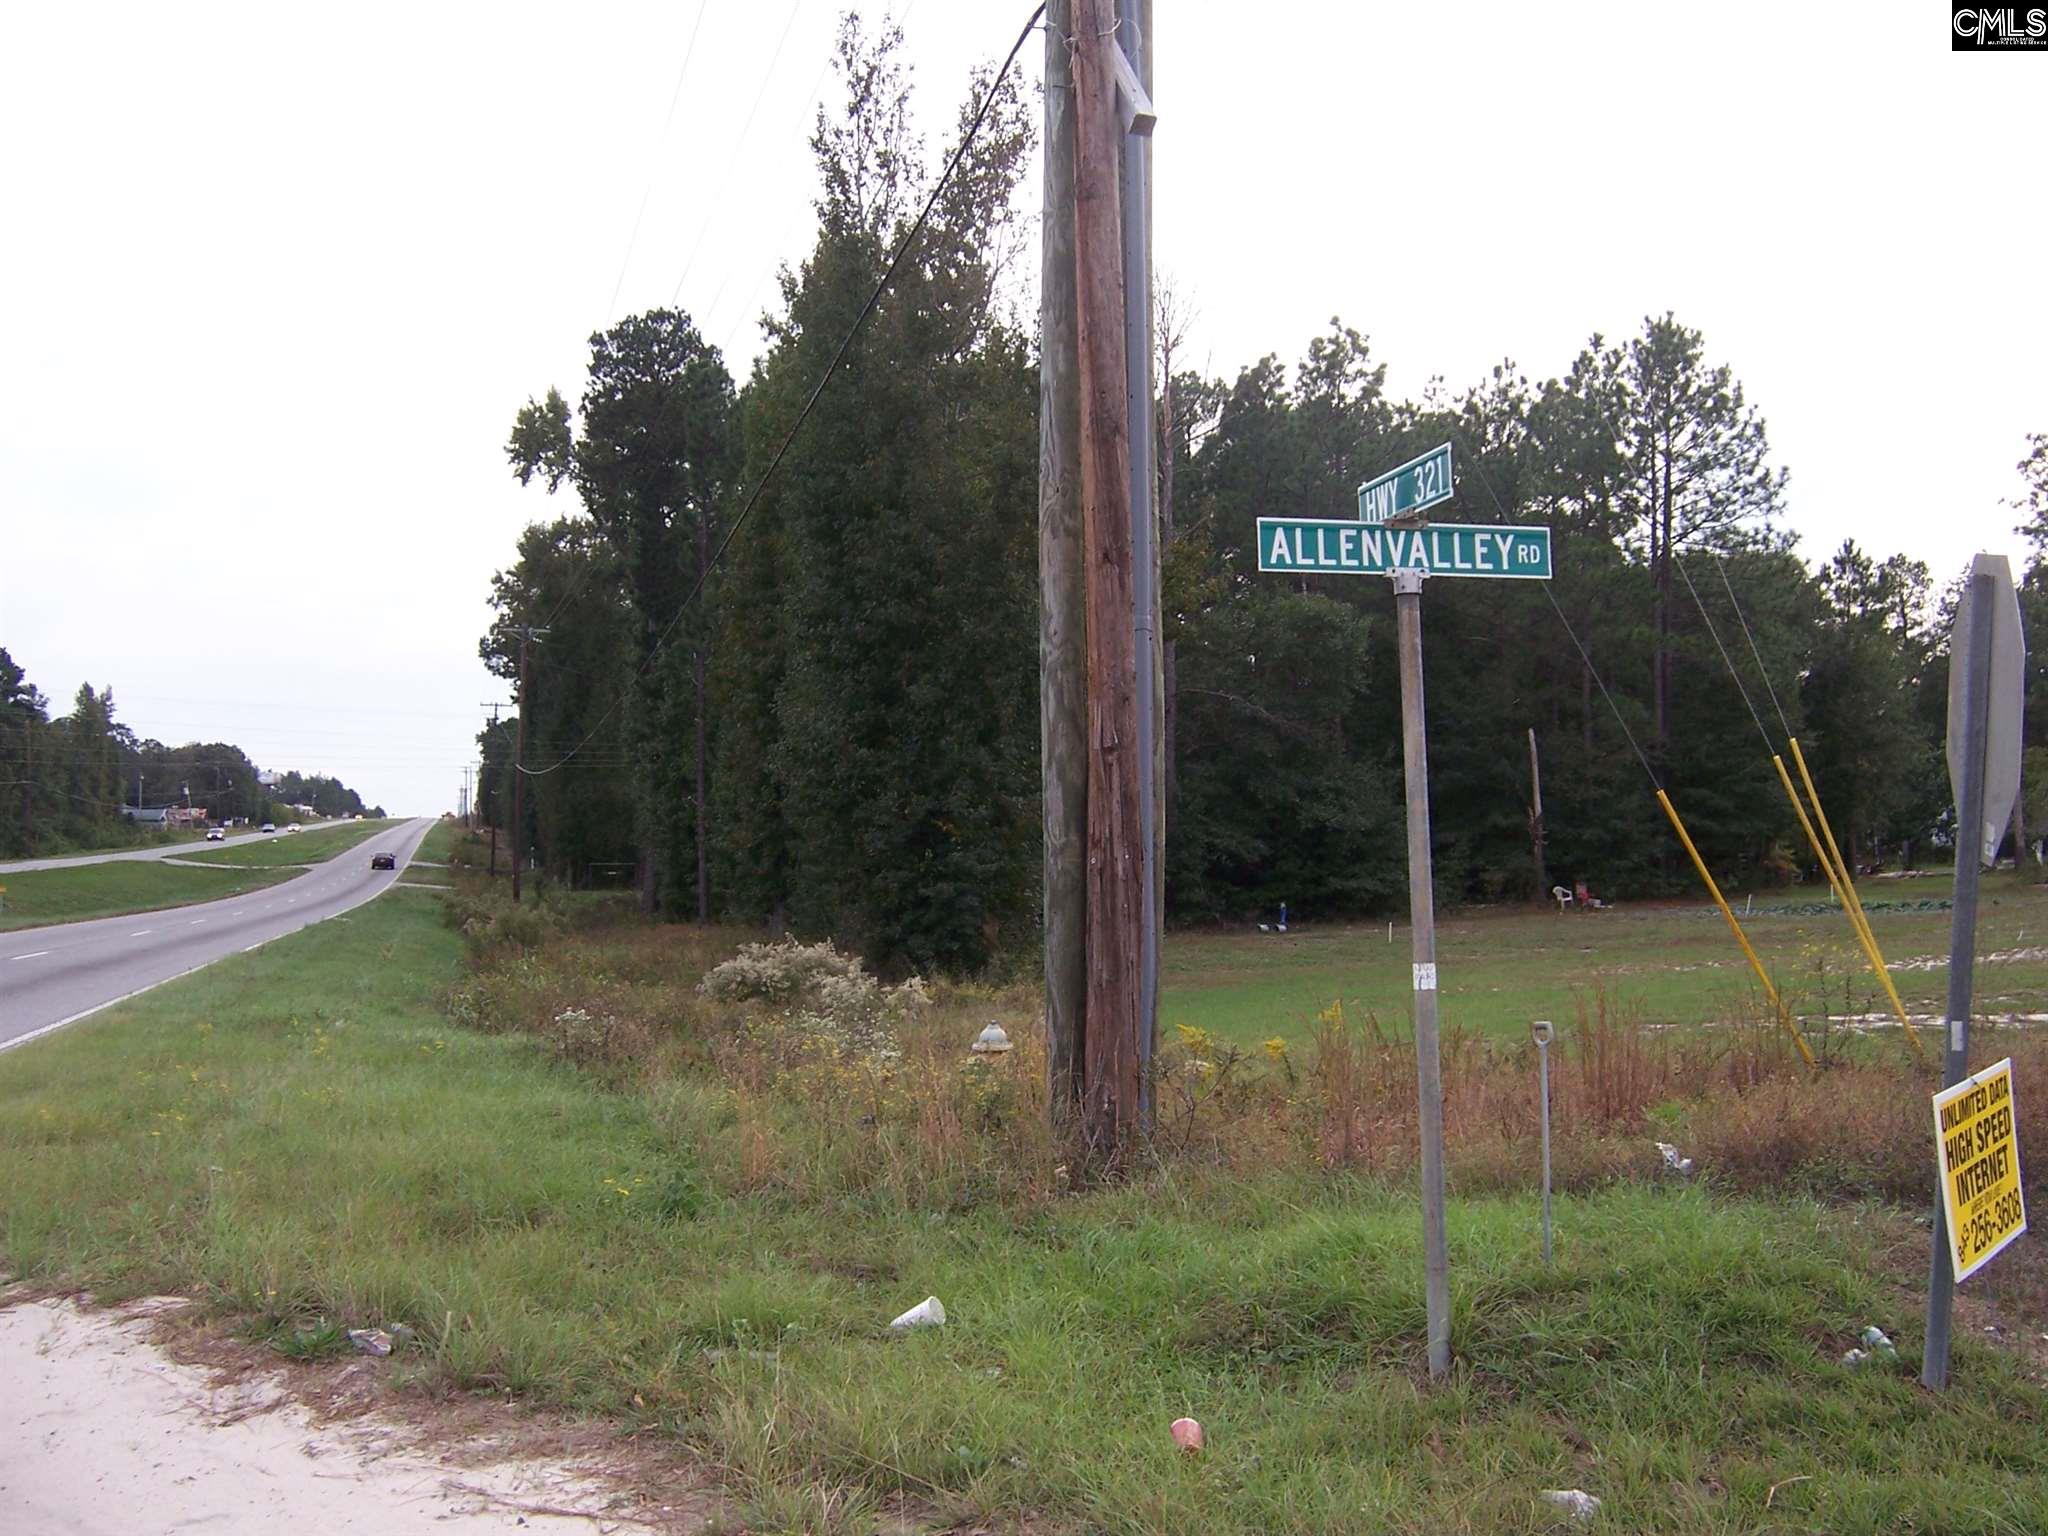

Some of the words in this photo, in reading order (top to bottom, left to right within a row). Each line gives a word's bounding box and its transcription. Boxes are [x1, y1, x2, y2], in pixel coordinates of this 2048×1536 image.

[1365, 478, 1398, 522] HWY
[1413, 455, 1445, 503] 321
[1270, 527, 1514, 570] ALLENVALLEY
[1518, 544, 1541, 564] RD
[1940, 1086, 1987, 1133] UNLIMITED
[1989, 1074, 2010, 1105] DATA
[1944, 1130, 1973, 1172] HIGH
[1976, 1105, 2011, 1152] SPEED
[1955, 1144, 2009, 1207] INTERNET
[1970, 1187, 2022, 1253] 256-3608
